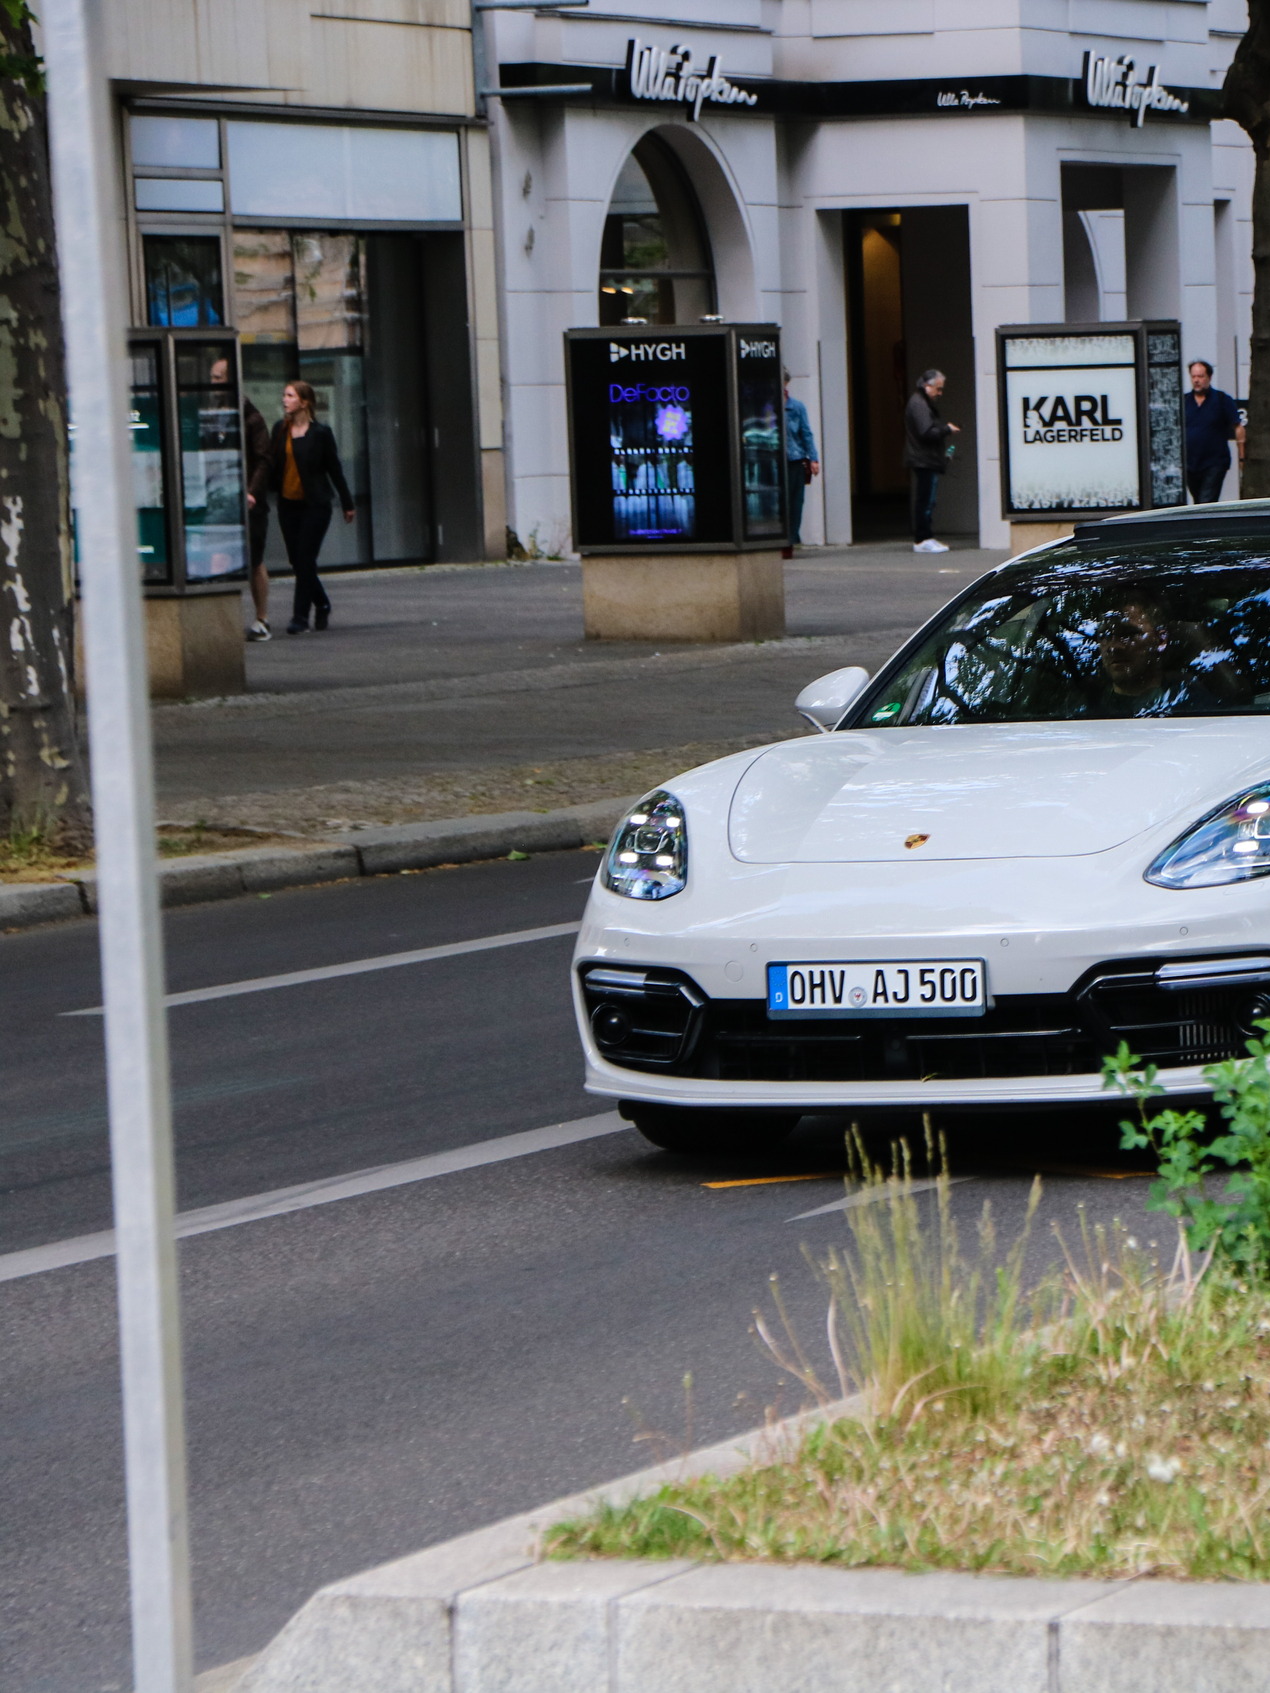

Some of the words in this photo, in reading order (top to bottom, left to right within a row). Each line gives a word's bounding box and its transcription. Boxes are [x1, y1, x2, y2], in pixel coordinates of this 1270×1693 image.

[676, 45, 758, 121] Popken
[631, 343, 686, 361] HYGH
[609, 383, 690, 403] DeFacto
[1022, 394, 1122, 428] KARL
[1024, 427, 1123, 444] LAGERFELD
[789, 969, 845, 1005] OHV
[872, 968, 910, 1004] AJ
[919, 967, 977, 1003] 500
